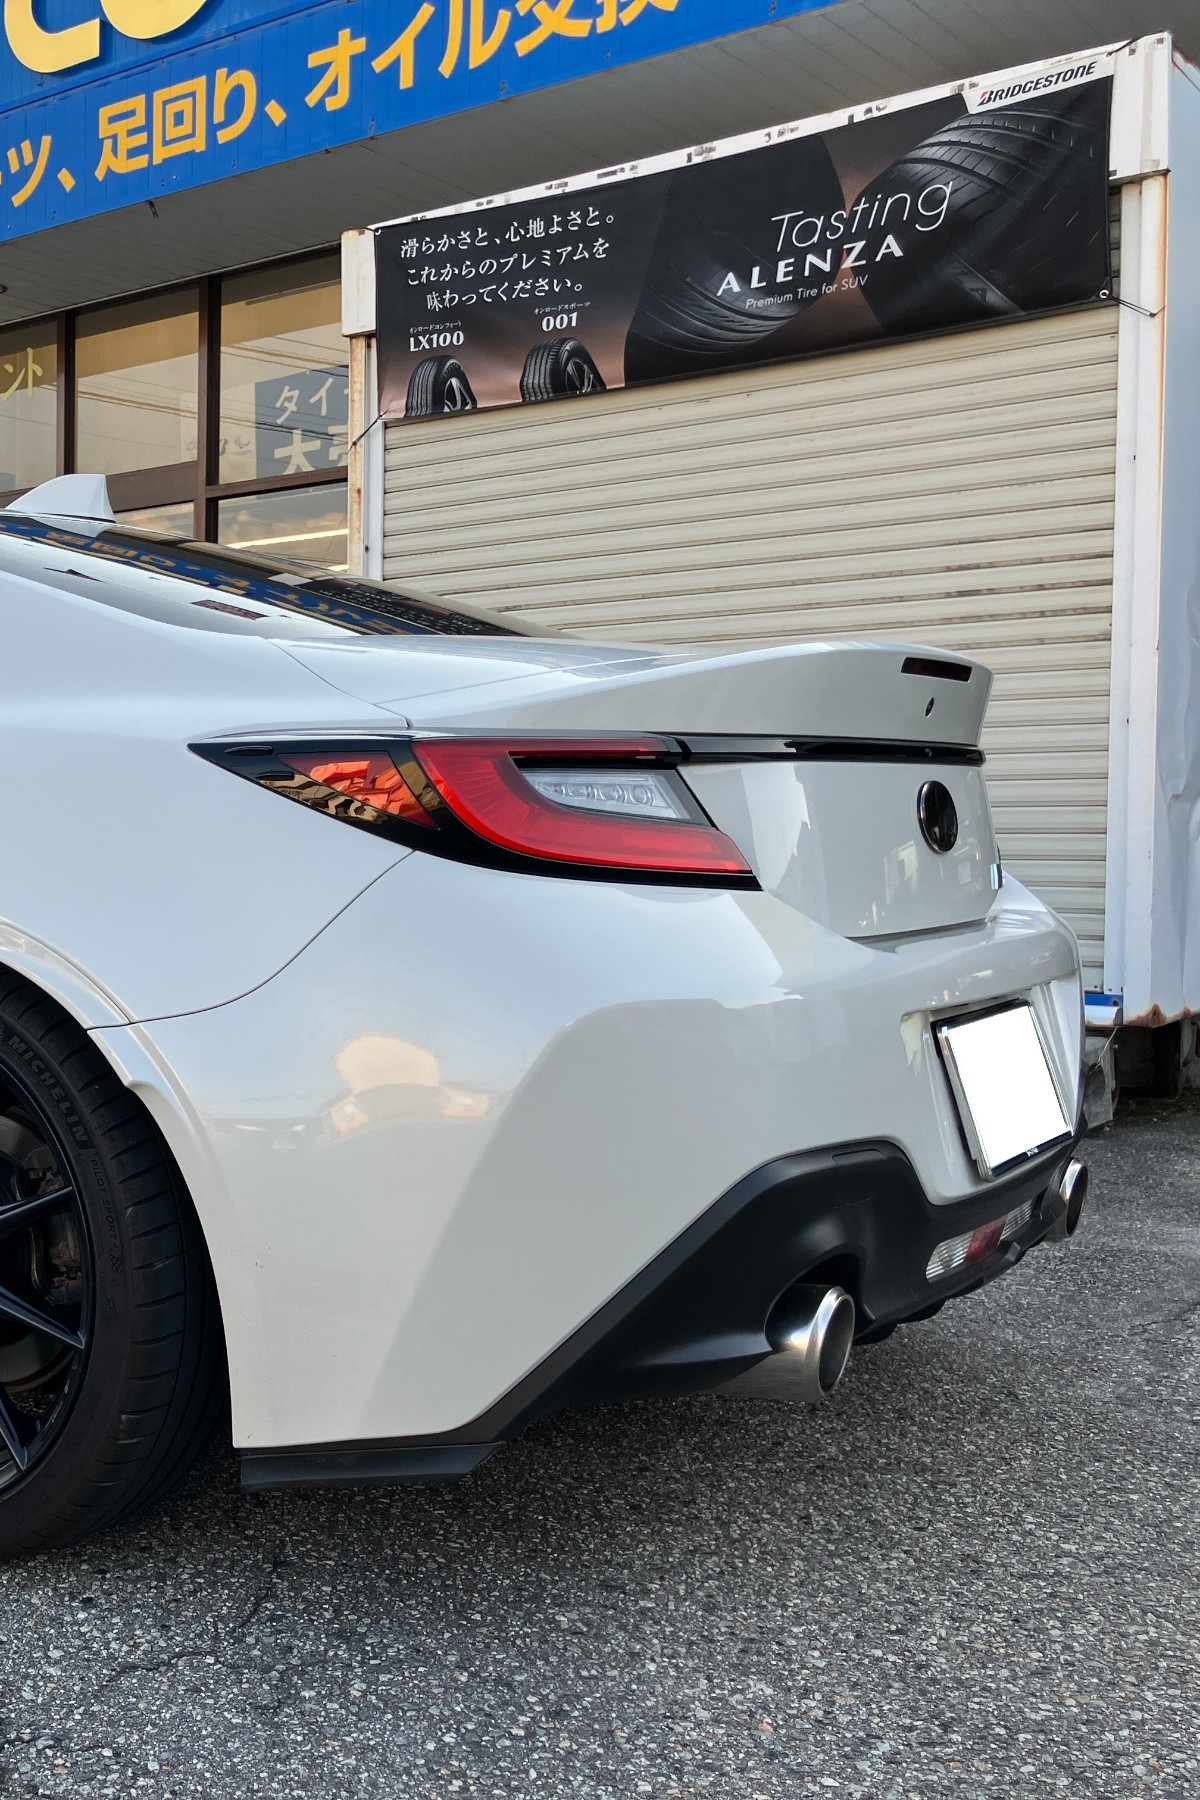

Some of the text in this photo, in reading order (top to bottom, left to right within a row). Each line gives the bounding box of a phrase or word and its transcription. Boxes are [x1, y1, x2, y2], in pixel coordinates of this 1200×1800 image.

[977, 61, 1097, 106] BRIDGESTONE
[401, 206, 615, 258] 滑らかさと、心地よさと。
[771, 181, 953, 252] Tasting
[407, 237, 610, 285] これからのプレミアムを
[717, 234, 904, 296] ALENZA
[427, 277, 583, 312] 味わってください。
[746, 274, 869, 310] Premium Tire for SUV
[409, 331, 465, 352] LX100
[542, 311, 578, 332] 001
[7, 1034, 89, 1143] MICHELIN
